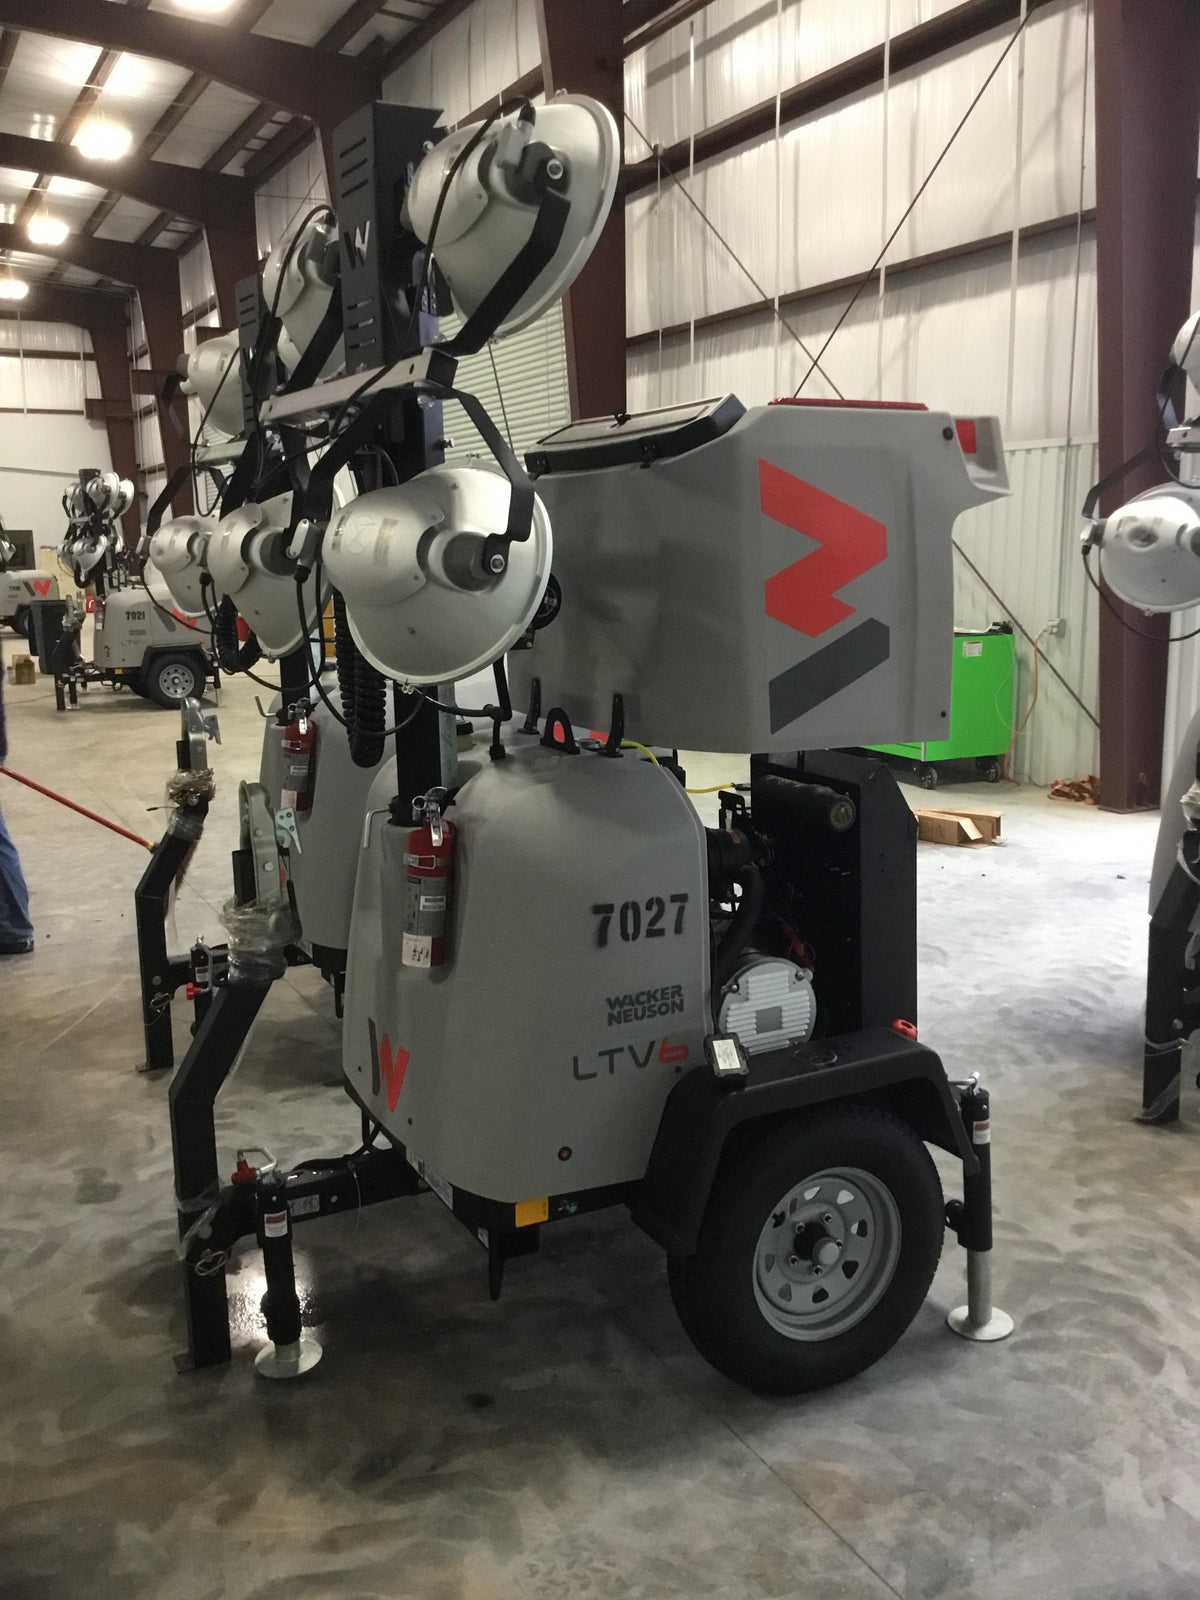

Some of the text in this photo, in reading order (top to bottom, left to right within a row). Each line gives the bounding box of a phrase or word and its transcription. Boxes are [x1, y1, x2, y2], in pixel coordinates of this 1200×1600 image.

[592, 894, 689, 947] 7027
[606, 985, 685, 1009] WACKER
[607, 999, 685, 1026] NEUSON
[573, 1038, 690, 1081] LTV6
